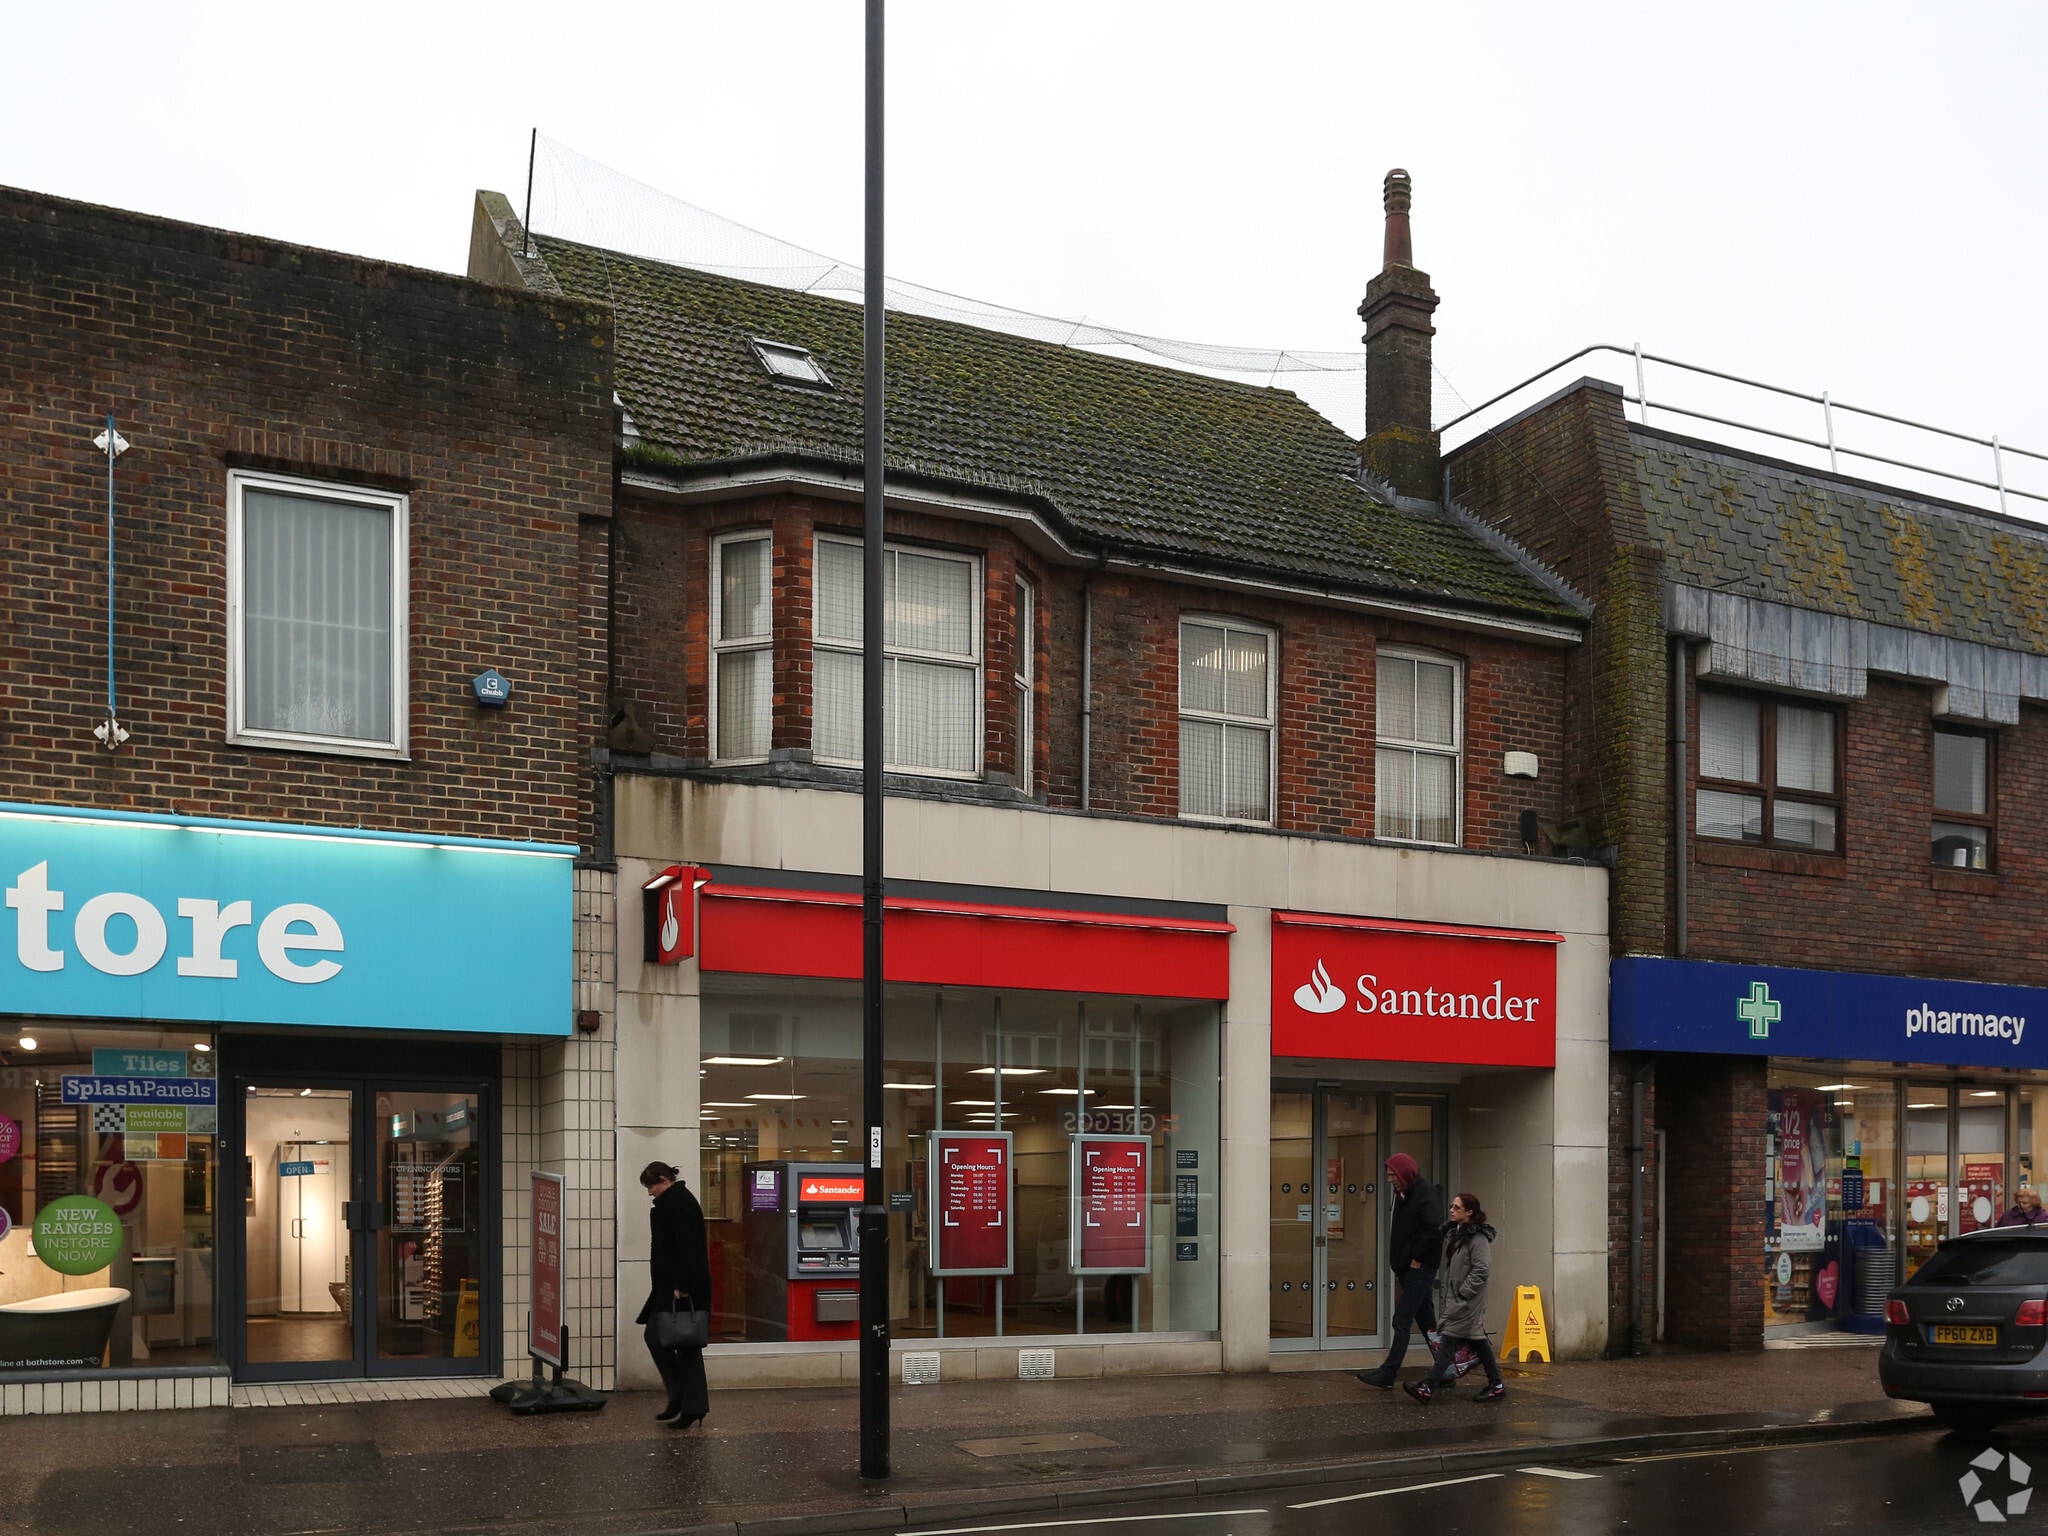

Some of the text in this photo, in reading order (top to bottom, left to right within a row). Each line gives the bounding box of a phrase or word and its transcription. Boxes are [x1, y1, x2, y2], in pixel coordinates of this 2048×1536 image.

[481, 688, 504, 696] Chubb
[1356, 974, 1540, 1022] Santander
[1906, 1002, 2025, 1045] pharmacy
[123, 1055, 210, 1073] Tiles &
[67, 1079, 211, 1100] SplashPanels
[129, 1109, 183, 1120] available
[1784, 1110, 1800, 1135] 1/2
[873, 1138, 879, 1148] 3
[1784, 1136, 1800, 1150] price
[286, 1166, 308, 1174] OPEN
[819, 1186, 860, 1194] Santander
[56, 1209, 98, 1221] NEW
[40, 1222, 113, 1235] RANGES
[539, 1212, 556, 1235] SALE
[45, 1238, 110, 1248] INSTORE
[58, 1251, 96, 1261] NOW
[1937, 1328, 1994, 1341] FP60 ZXB
